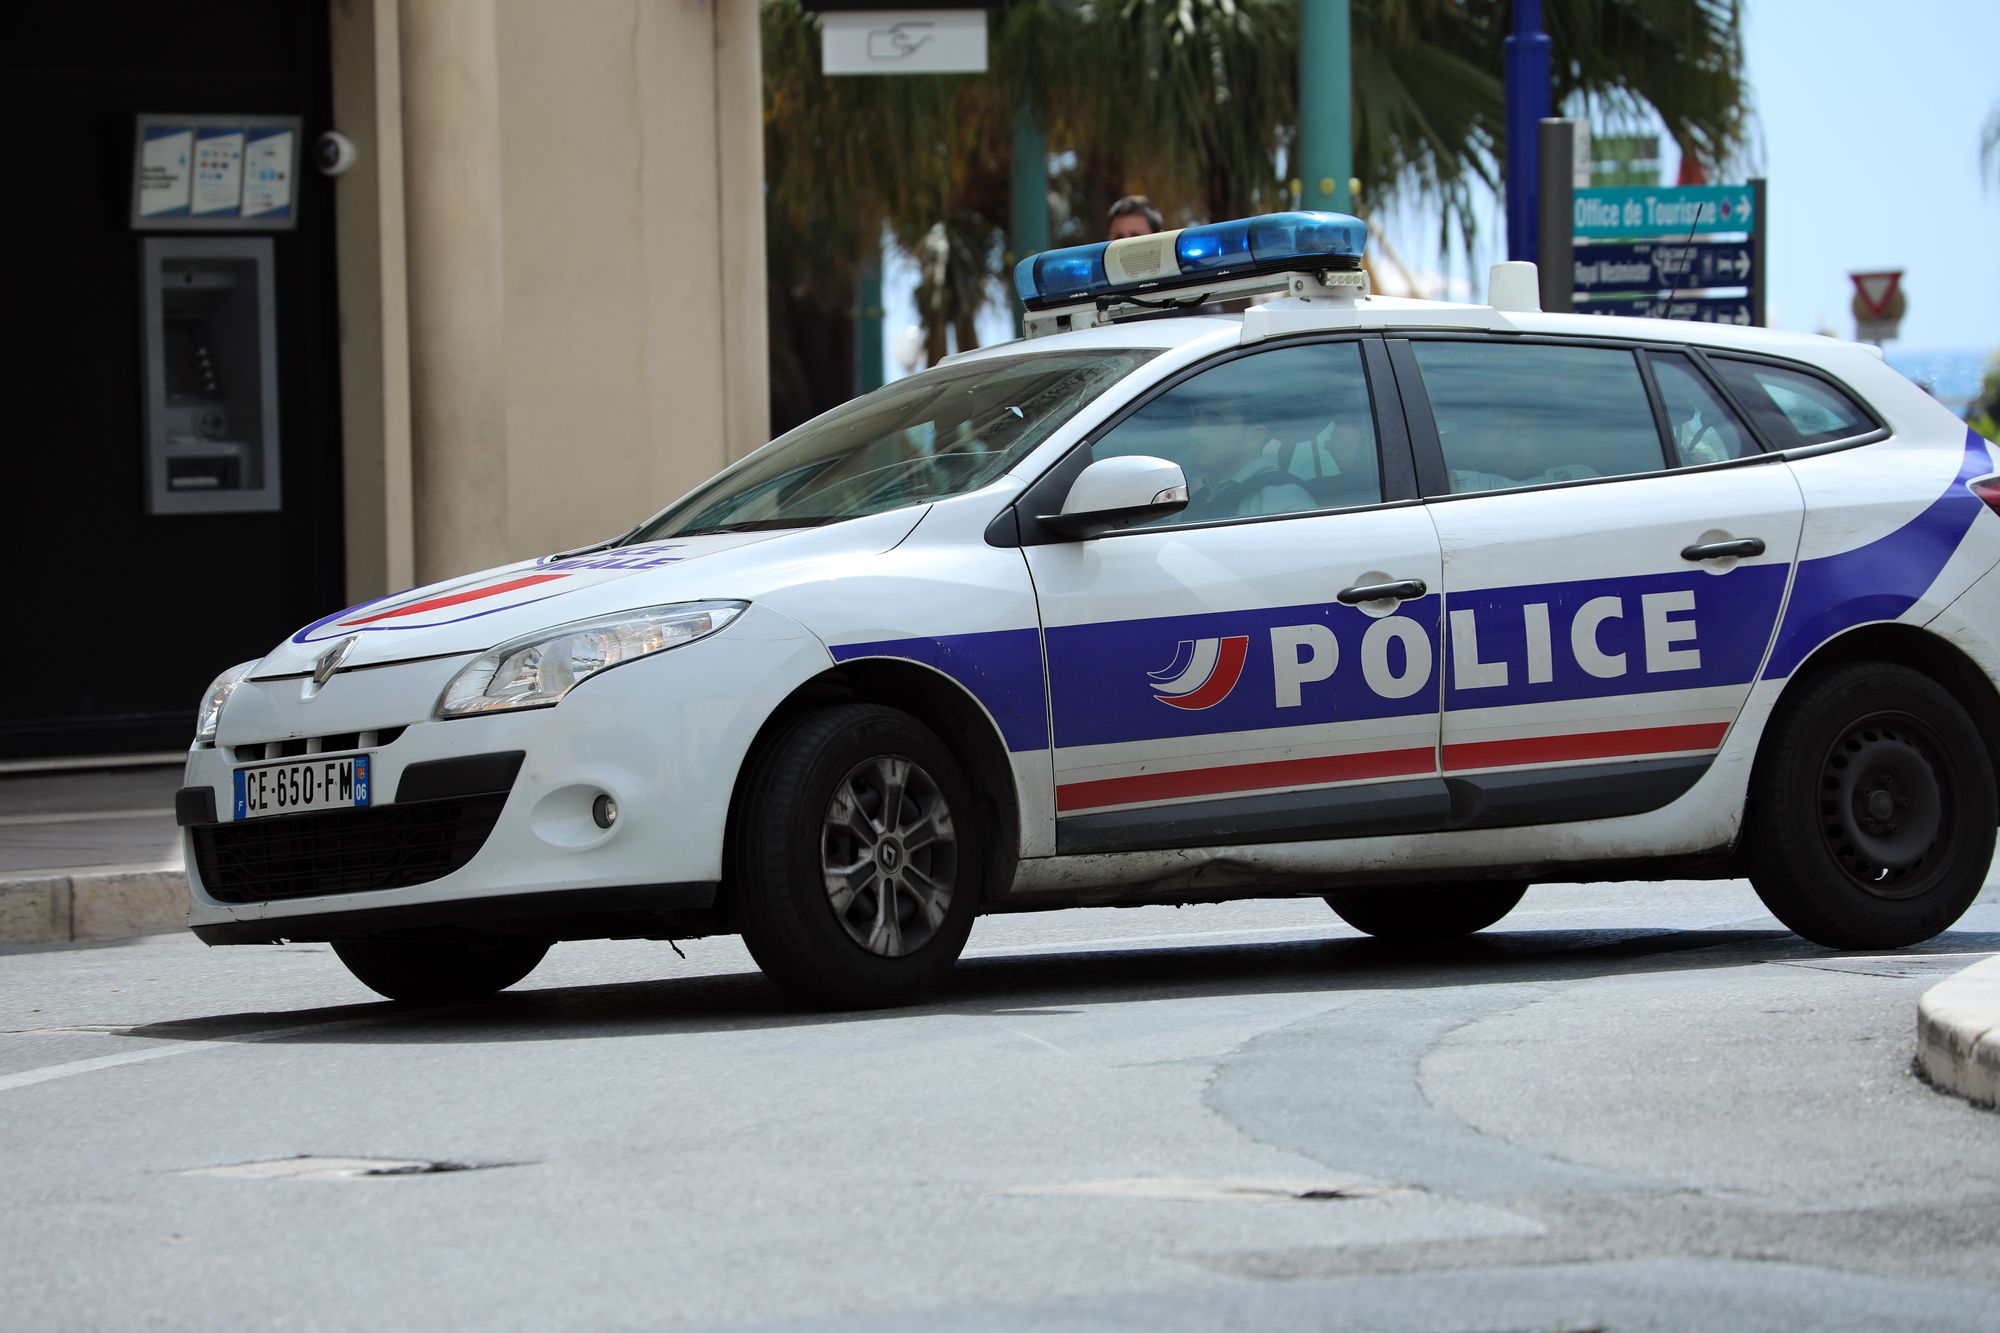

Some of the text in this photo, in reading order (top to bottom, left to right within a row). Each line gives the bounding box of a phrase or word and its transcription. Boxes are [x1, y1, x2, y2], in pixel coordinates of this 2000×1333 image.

[1575, 196, 1717, 227] Office de Tourisme
[1270, 590, 1702, 709] POLICE
[238, 800, 244, 812] F
[247, 762, 352, 811] CE-650-FM
[355, 783, 367, 801] 06
